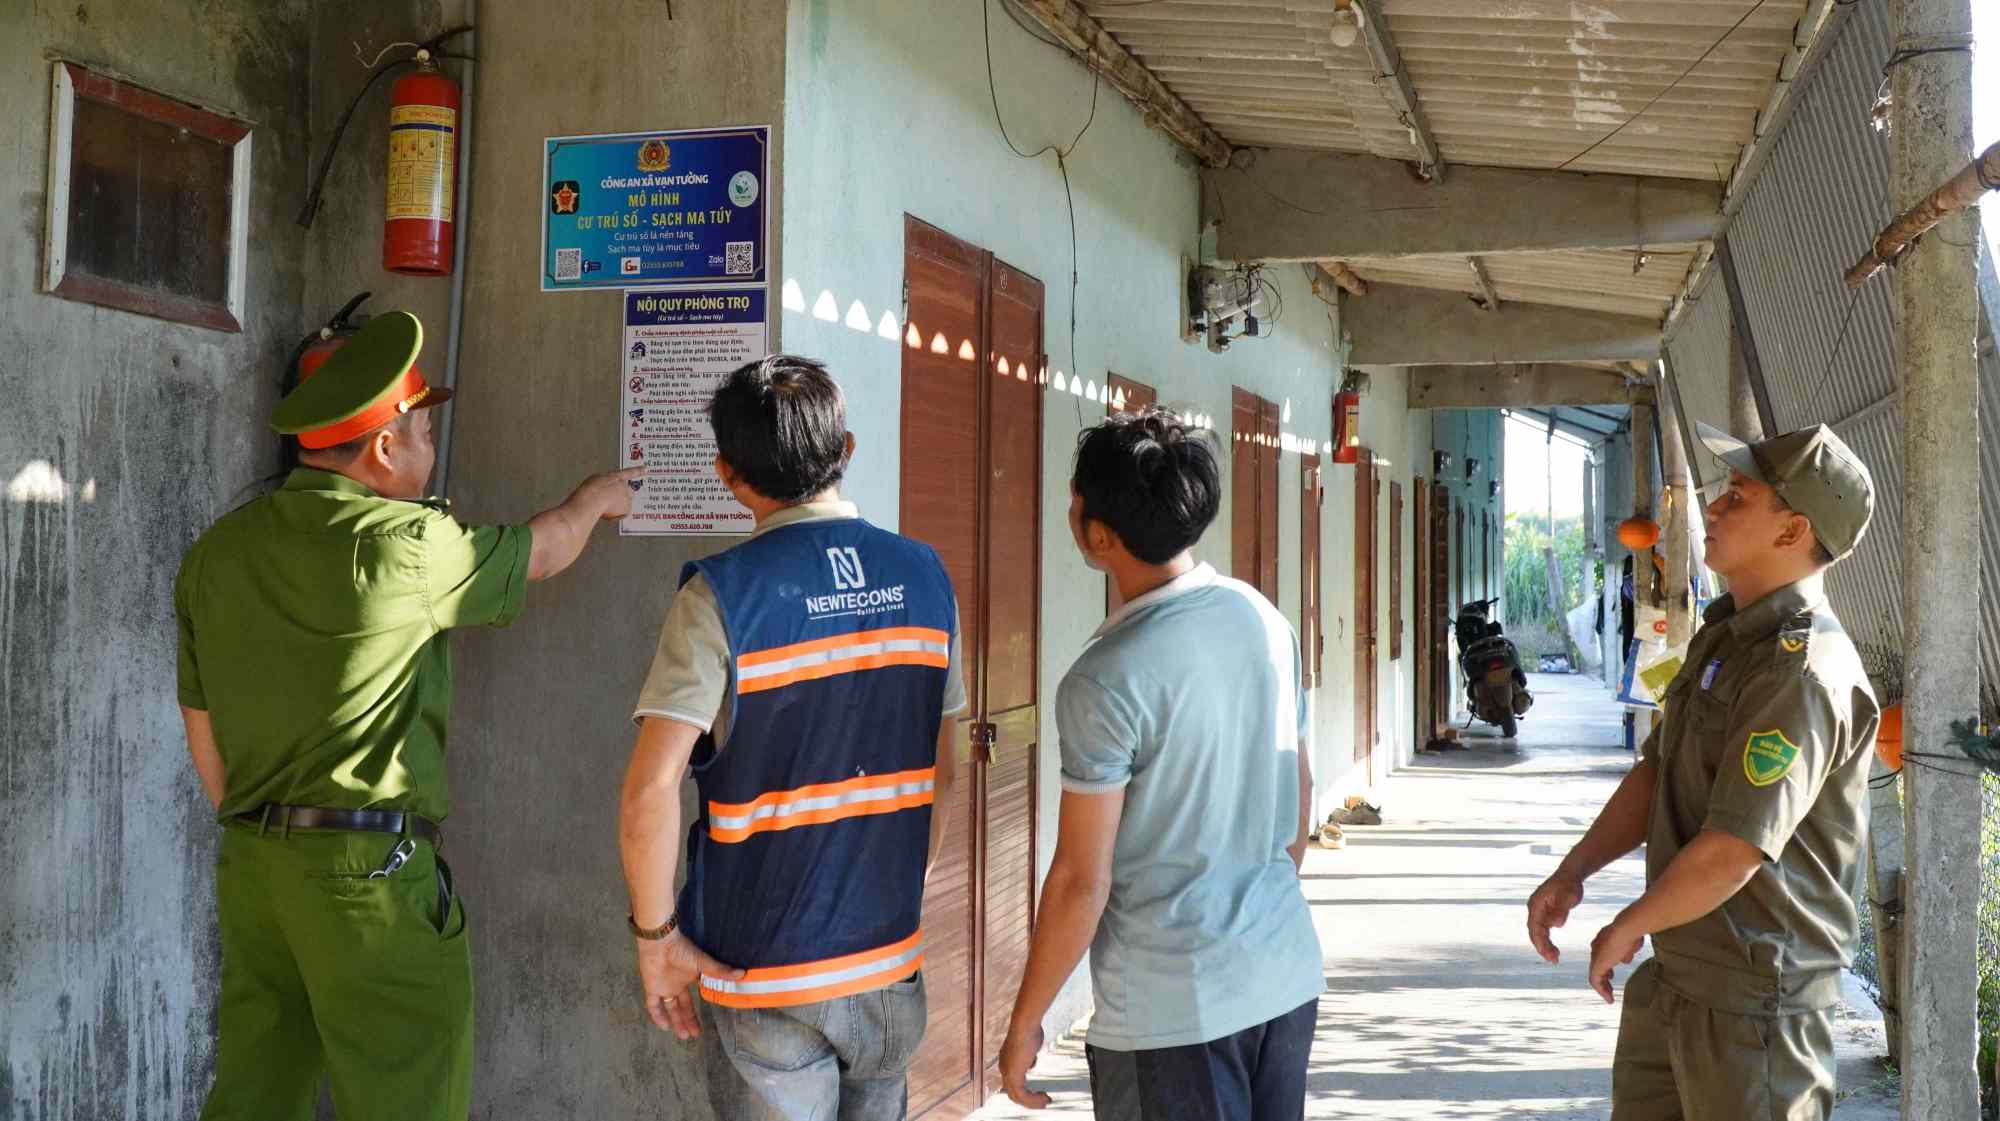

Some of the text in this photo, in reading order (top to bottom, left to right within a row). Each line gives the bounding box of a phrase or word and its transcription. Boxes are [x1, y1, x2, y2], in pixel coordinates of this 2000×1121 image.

[600, 172, 709, 189] CÔNG AN XÃ VẠN TƯỜNG
[628, 190, 680, 207] MÔ HÌNH
[577, 214, 594, 230] CƯ
[597, 210, 619, 228] TRÚ
[623, 209, 640, 228] SỐ
[652, 212, 682, 229] SẠCH
[687, 212, 706, 225] MA
[710, 206, 732, 224] TÚY
[636, 295, 750, 314] NỘI QUY PHÒNG TRỌ
[677, 512, 694, 520] CÔNG
[806, 586, 903, 613] NEWTECONS
